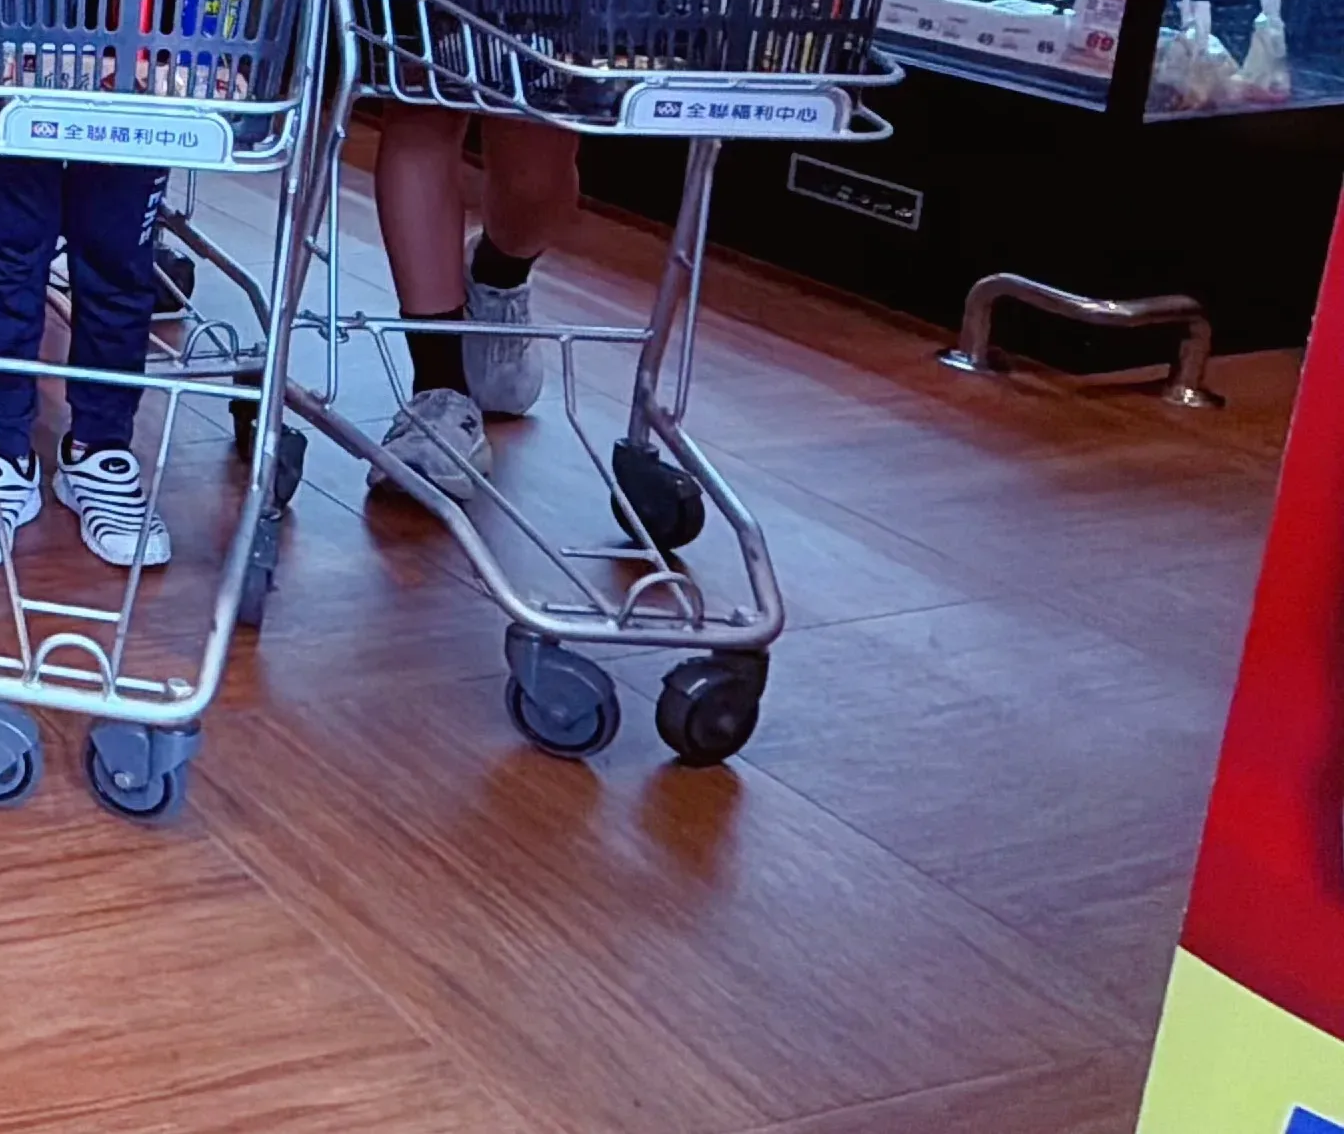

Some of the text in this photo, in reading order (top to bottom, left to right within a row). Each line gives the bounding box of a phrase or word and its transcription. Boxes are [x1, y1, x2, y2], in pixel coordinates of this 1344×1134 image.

[687, 102, 818, 123] 全聯福利中心
[64, 124, 200, 148] 全聯福利中心
